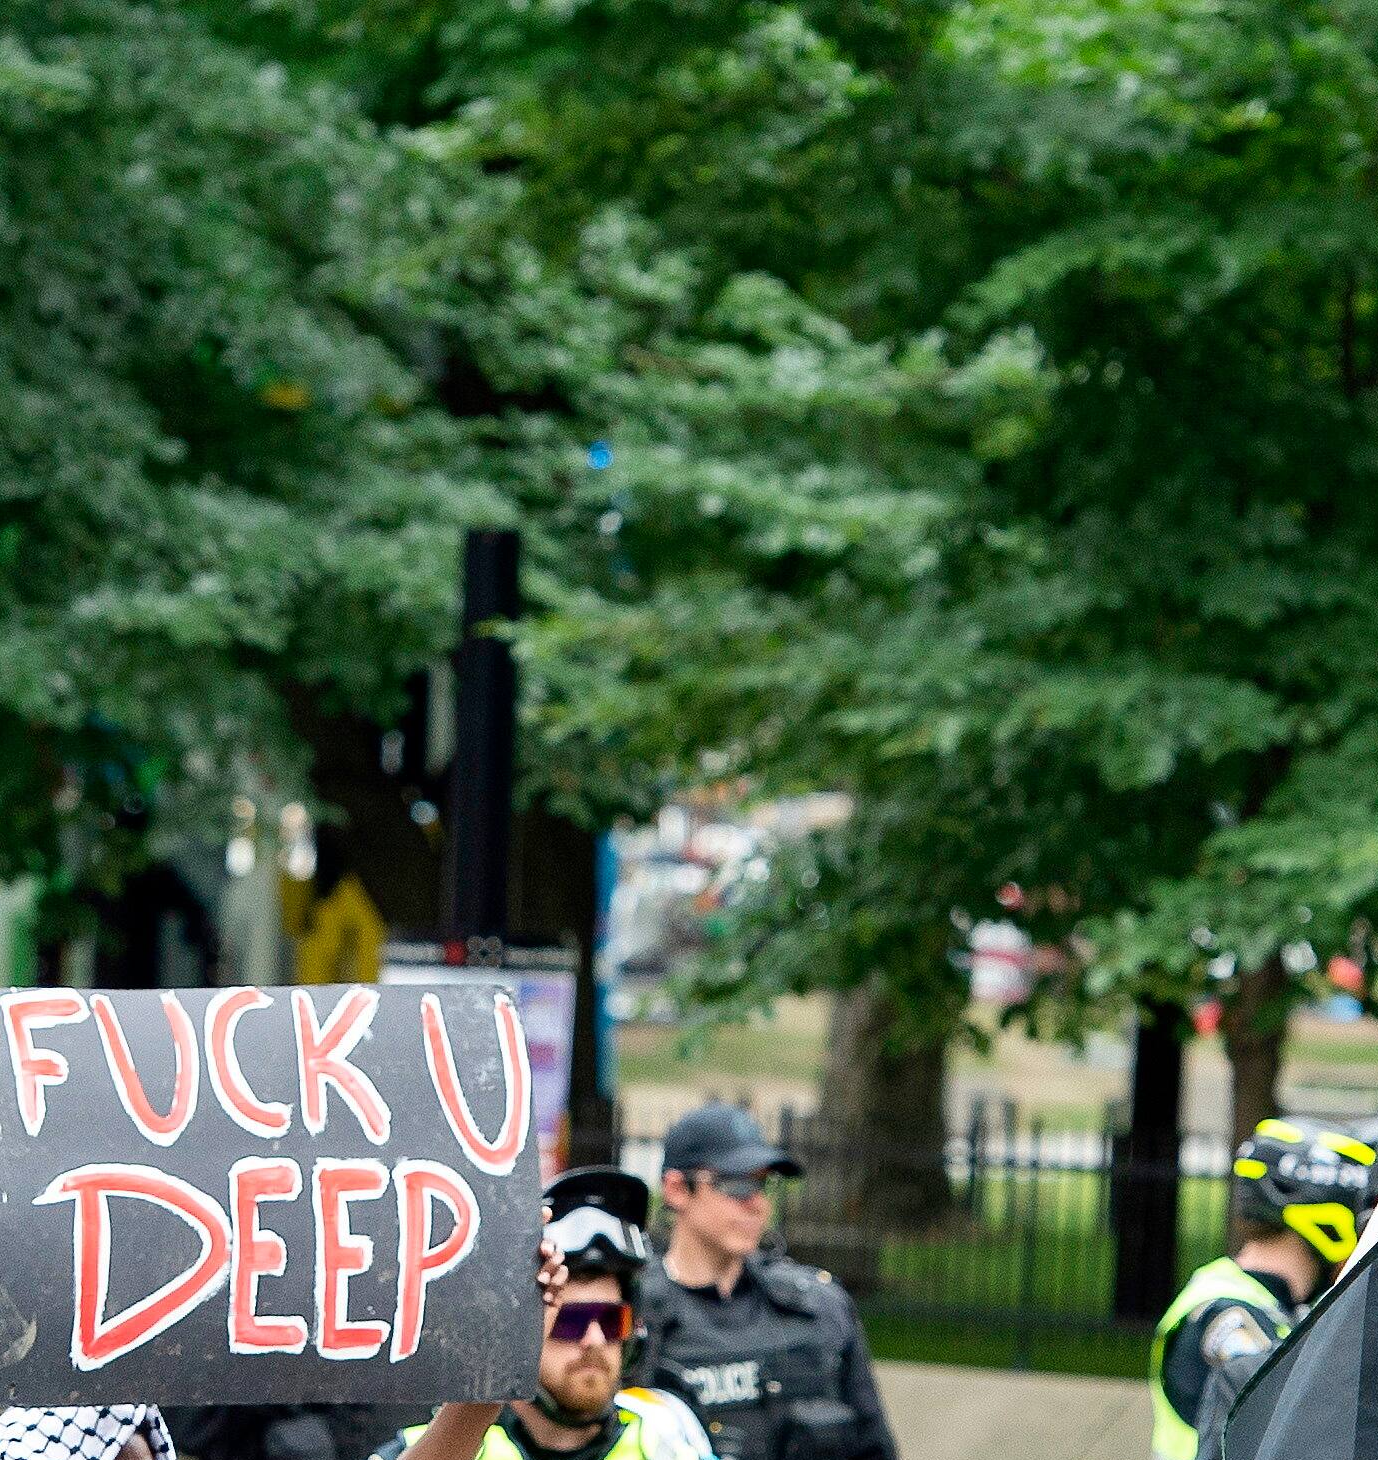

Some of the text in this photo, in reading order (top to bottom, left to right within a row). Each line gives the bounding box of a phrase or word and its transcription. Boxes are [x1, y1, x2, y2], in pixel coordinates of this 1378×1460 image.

[0, 987, 532, 1175] FUCK U
[32, 1156, 481, 1371] DEEP
